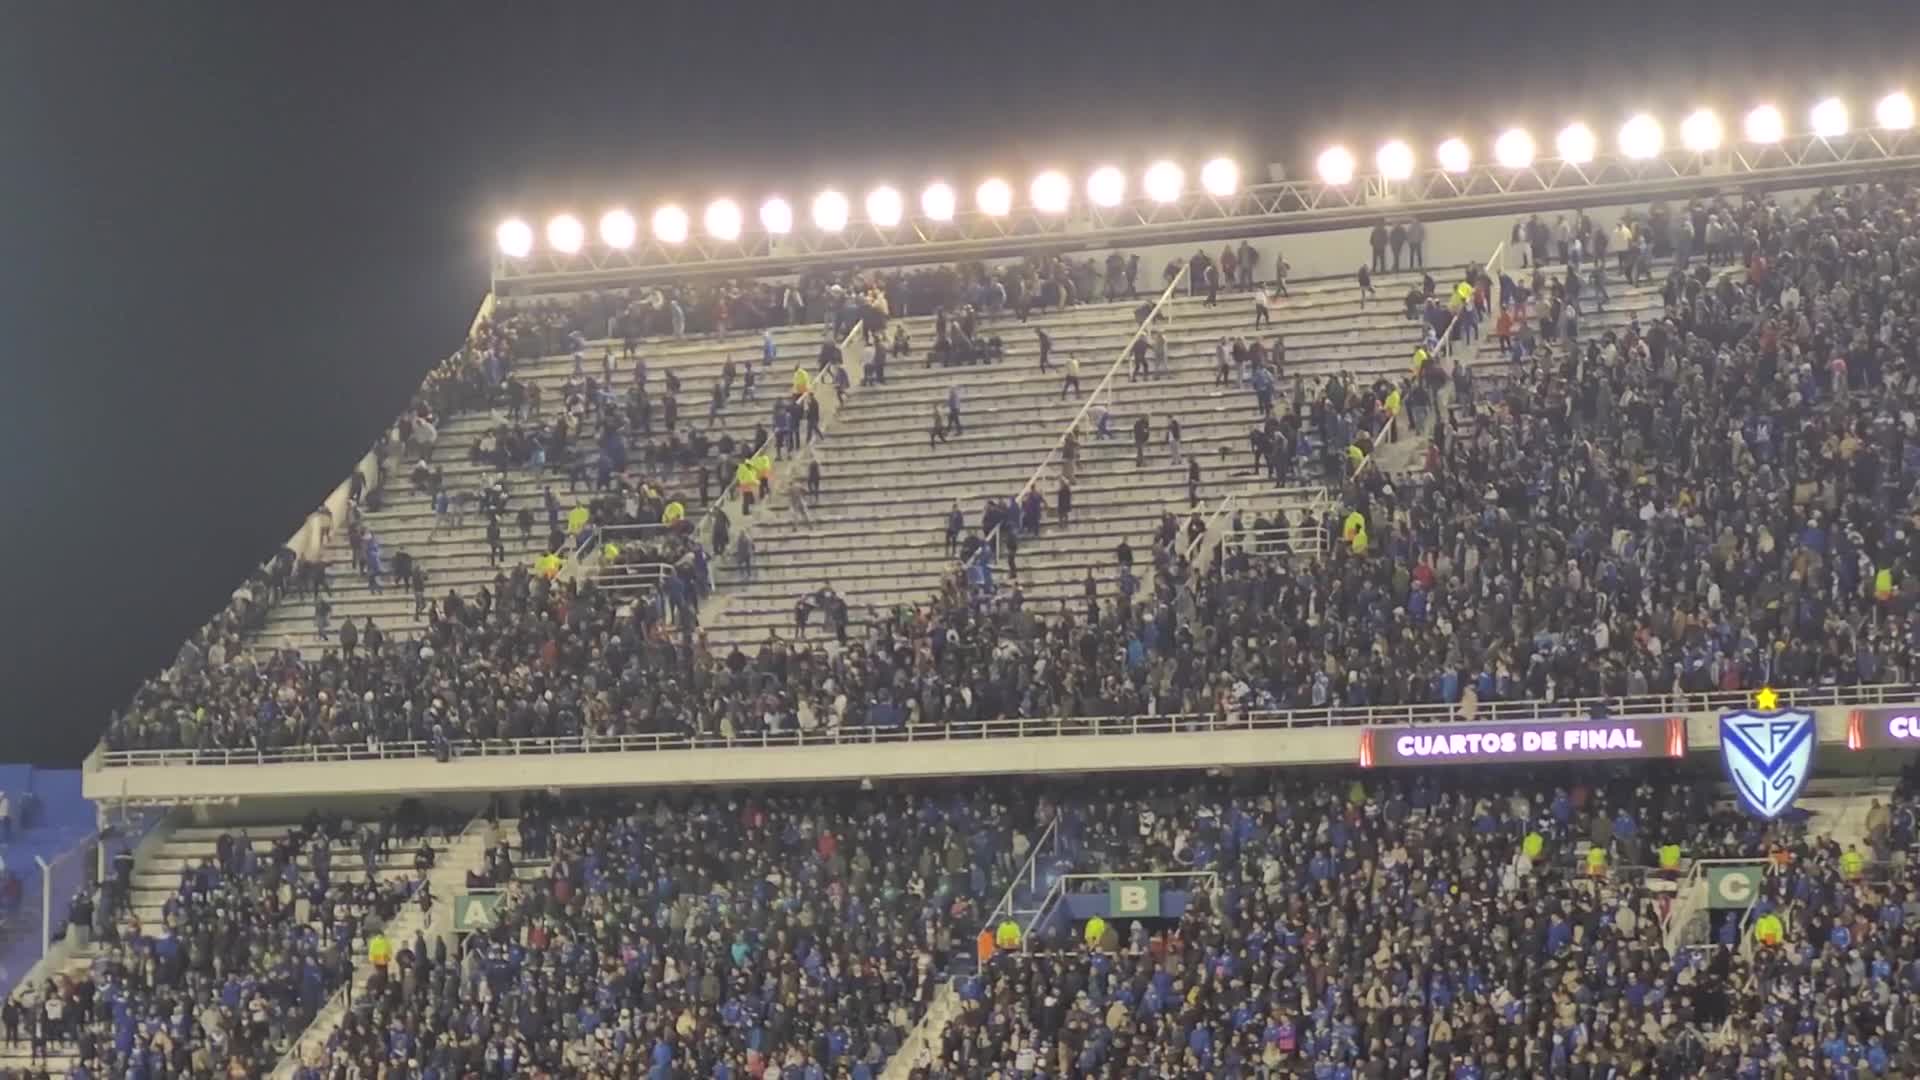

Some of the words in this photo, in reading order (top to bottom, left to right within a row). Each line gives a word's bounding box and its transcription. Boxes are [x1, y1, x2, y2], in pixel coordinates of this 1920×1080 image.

[1397, 732, 1516, 756] CUARTOS
[1522, 730, 1557, 751] DE
[1563, 728, 1642, 750] FINAL
[1120, 886, 1147, 912] B
[1719, 872, 1750, 901] C
[463, 900, 490, 925] A
